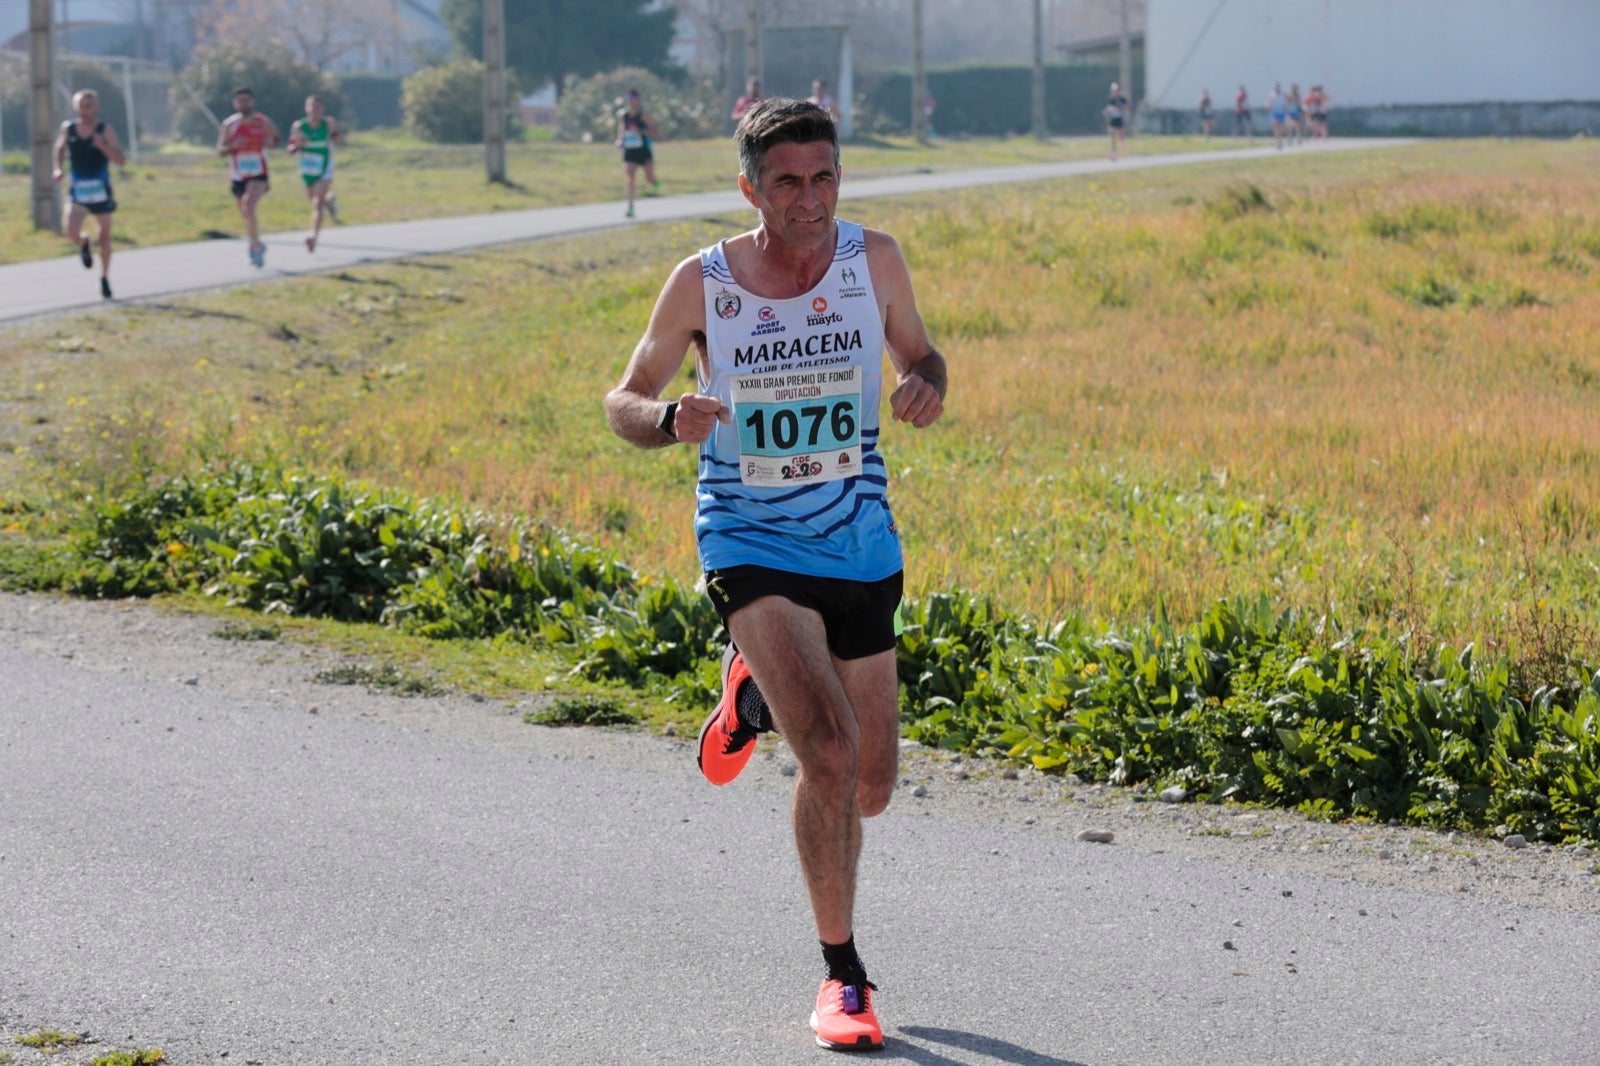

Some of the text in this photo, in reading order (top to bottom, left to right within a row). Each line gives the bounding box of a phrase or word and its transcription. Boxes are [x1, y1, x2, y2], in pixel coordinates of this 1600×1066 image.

[756, 320, 780, 331] SPORT
[806, 312, 843, 326] mayfo
[751, 326, 786, 336] GARRIDO
[734, 330, 862, 367] MARACENA
[752, 365, 778, 374] CLUB
[795, 356, 850, 369] ATLETISMO
[763, 377, 785, 389] GRAN
[787, 374, 816, 387] PREMIO
[817, 372, 827, 383] DE
[829, 370, 854, 383] FONDO
[775, 385, 821, 401] DIPUTACIÓN
[746, 401, 855, 450] 1076
